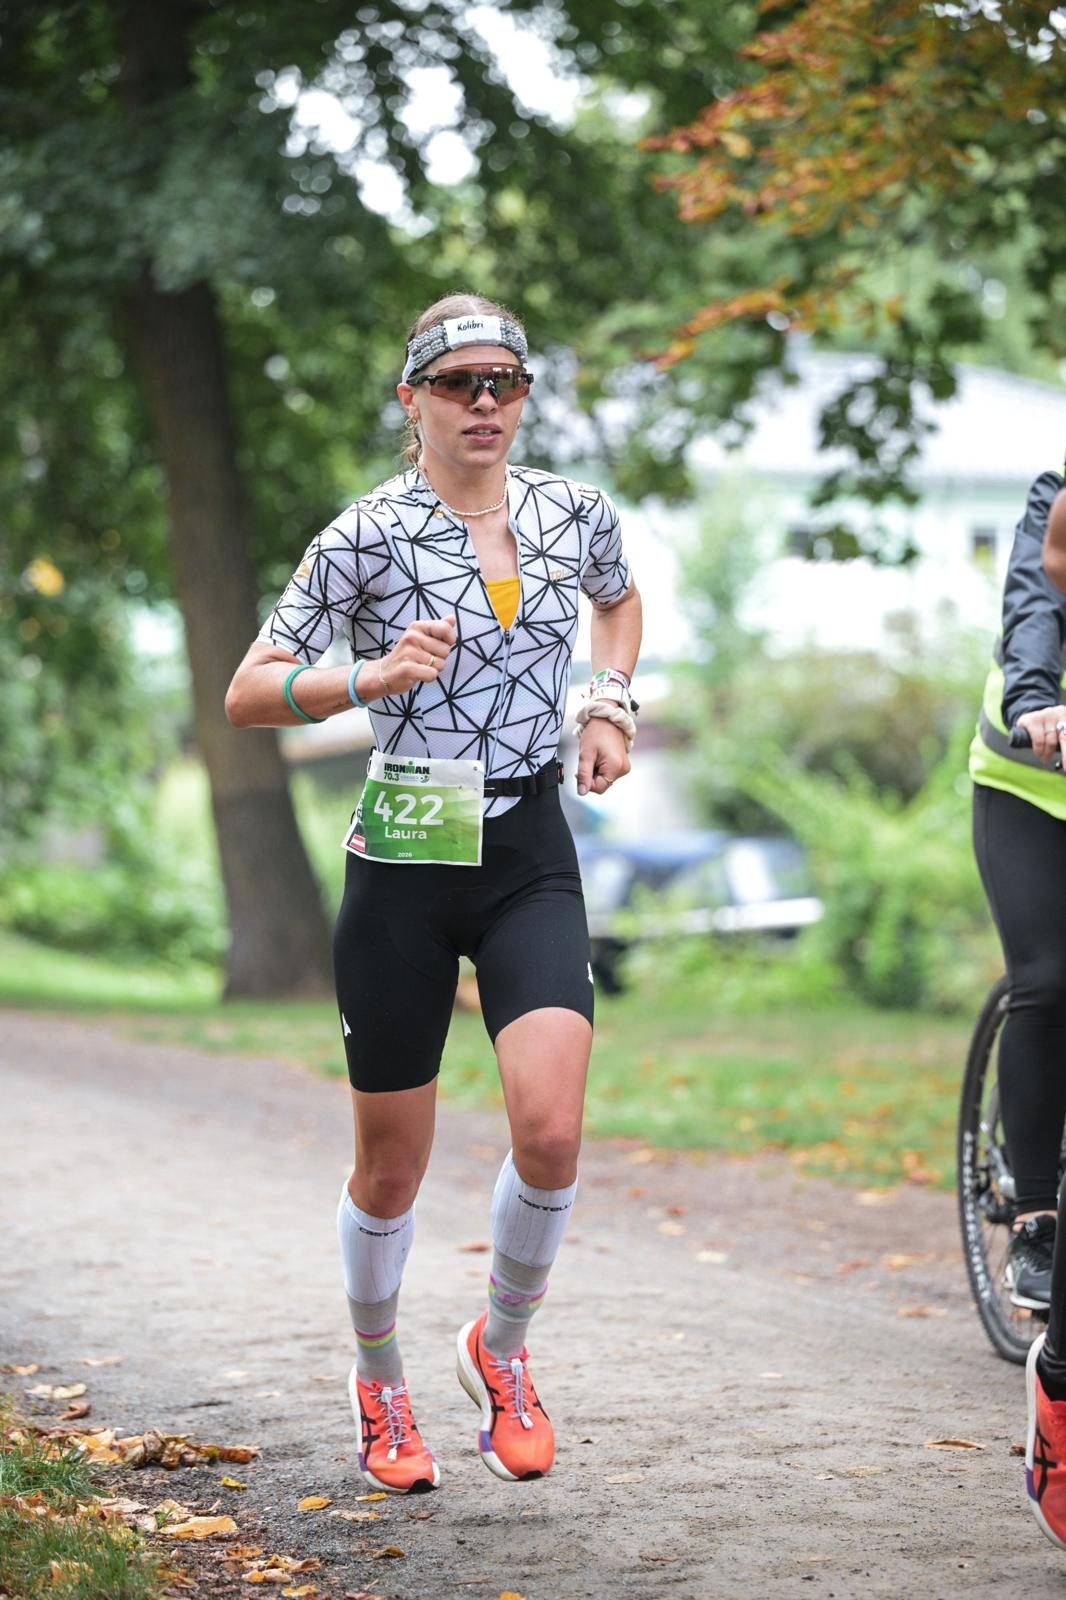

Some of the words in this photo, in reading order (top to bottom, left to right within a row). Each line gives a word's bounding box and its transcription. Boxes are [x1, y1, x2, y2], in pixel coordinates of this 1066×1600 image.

[457, 319, 483, 332] Kolibri
[384, 761, 430, 775] IRONMAN
[384, 772, 400, 781] 70.3
[374, 791, 444, 825] 422
[385, 826, 427, 839] Laura
